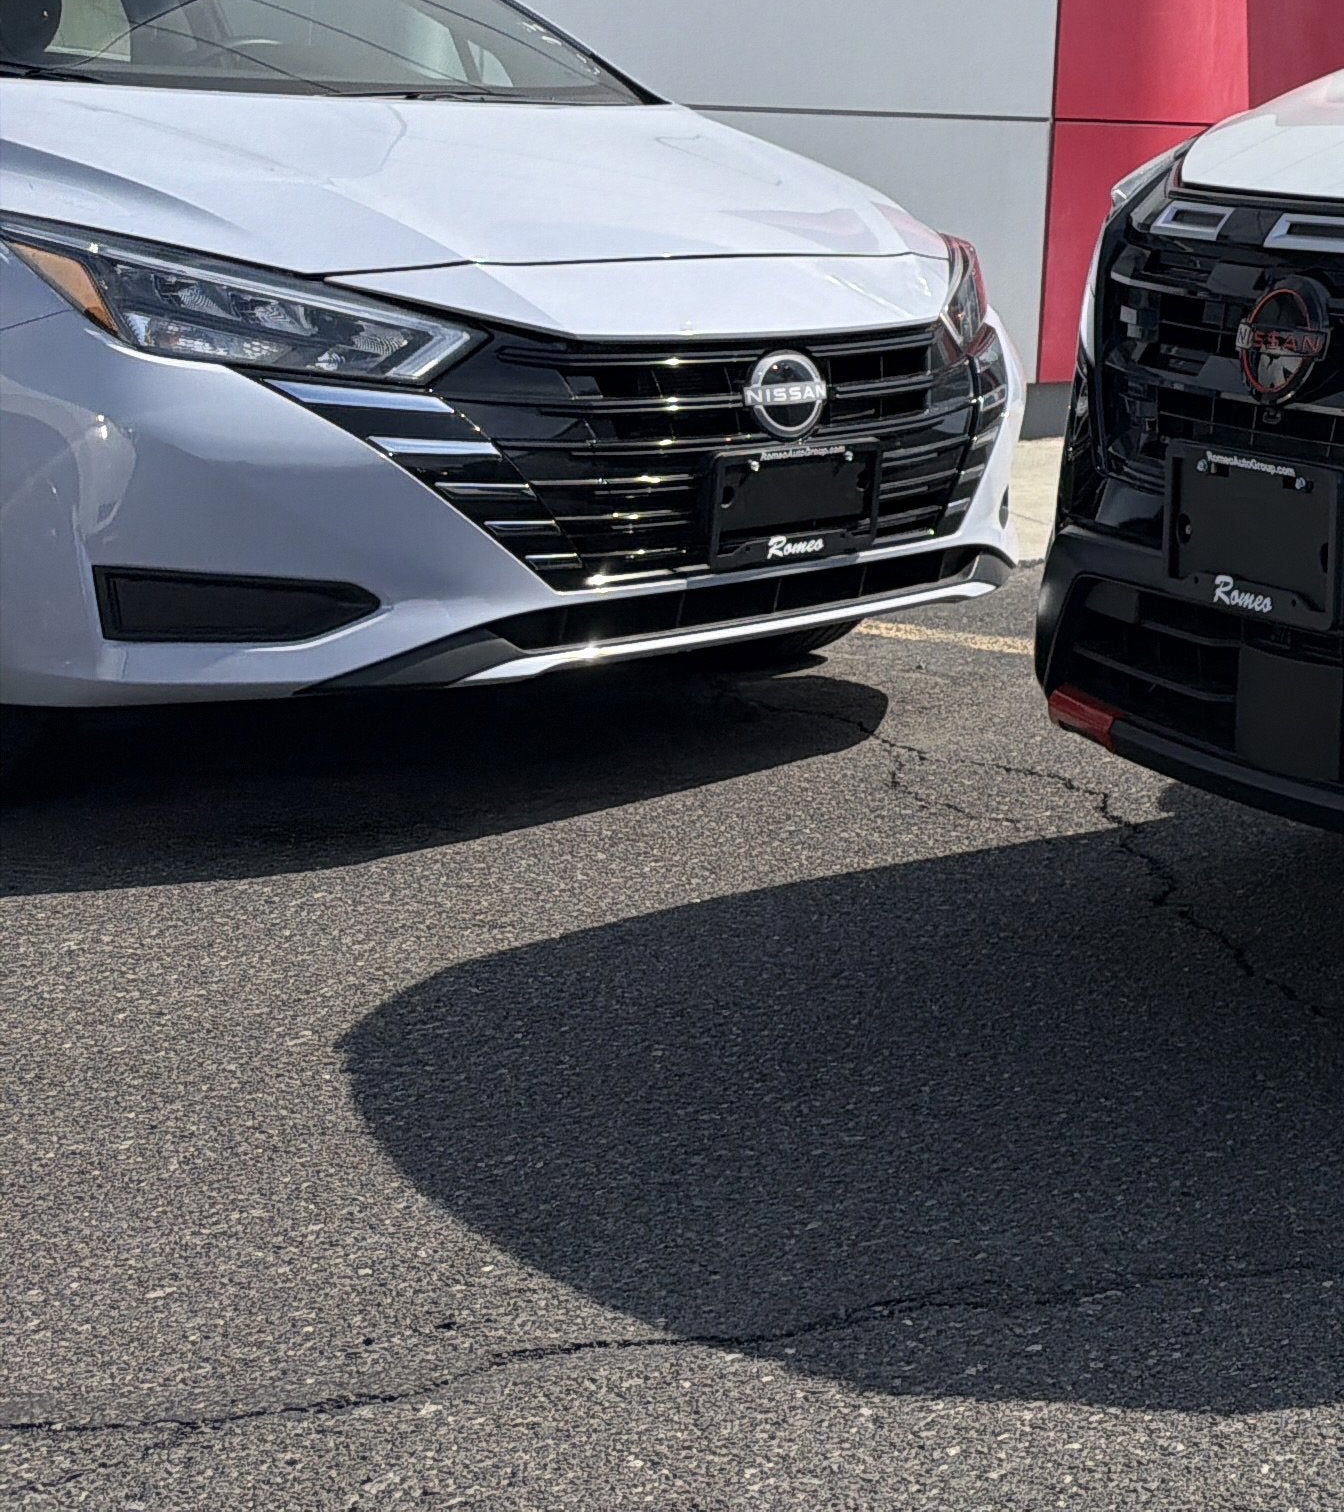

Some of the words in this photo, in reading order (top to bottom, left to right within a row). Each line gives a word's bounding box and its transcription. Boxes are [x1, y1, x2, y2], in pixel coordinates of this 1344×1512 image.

[745, 384, 826, 404] NISSAN
[1206, 450, 1297, 478] RomeoAutoGroup.com
[767, 535, 824, 560] Romeo
[1213, 574, 1273, 613] Romeo
